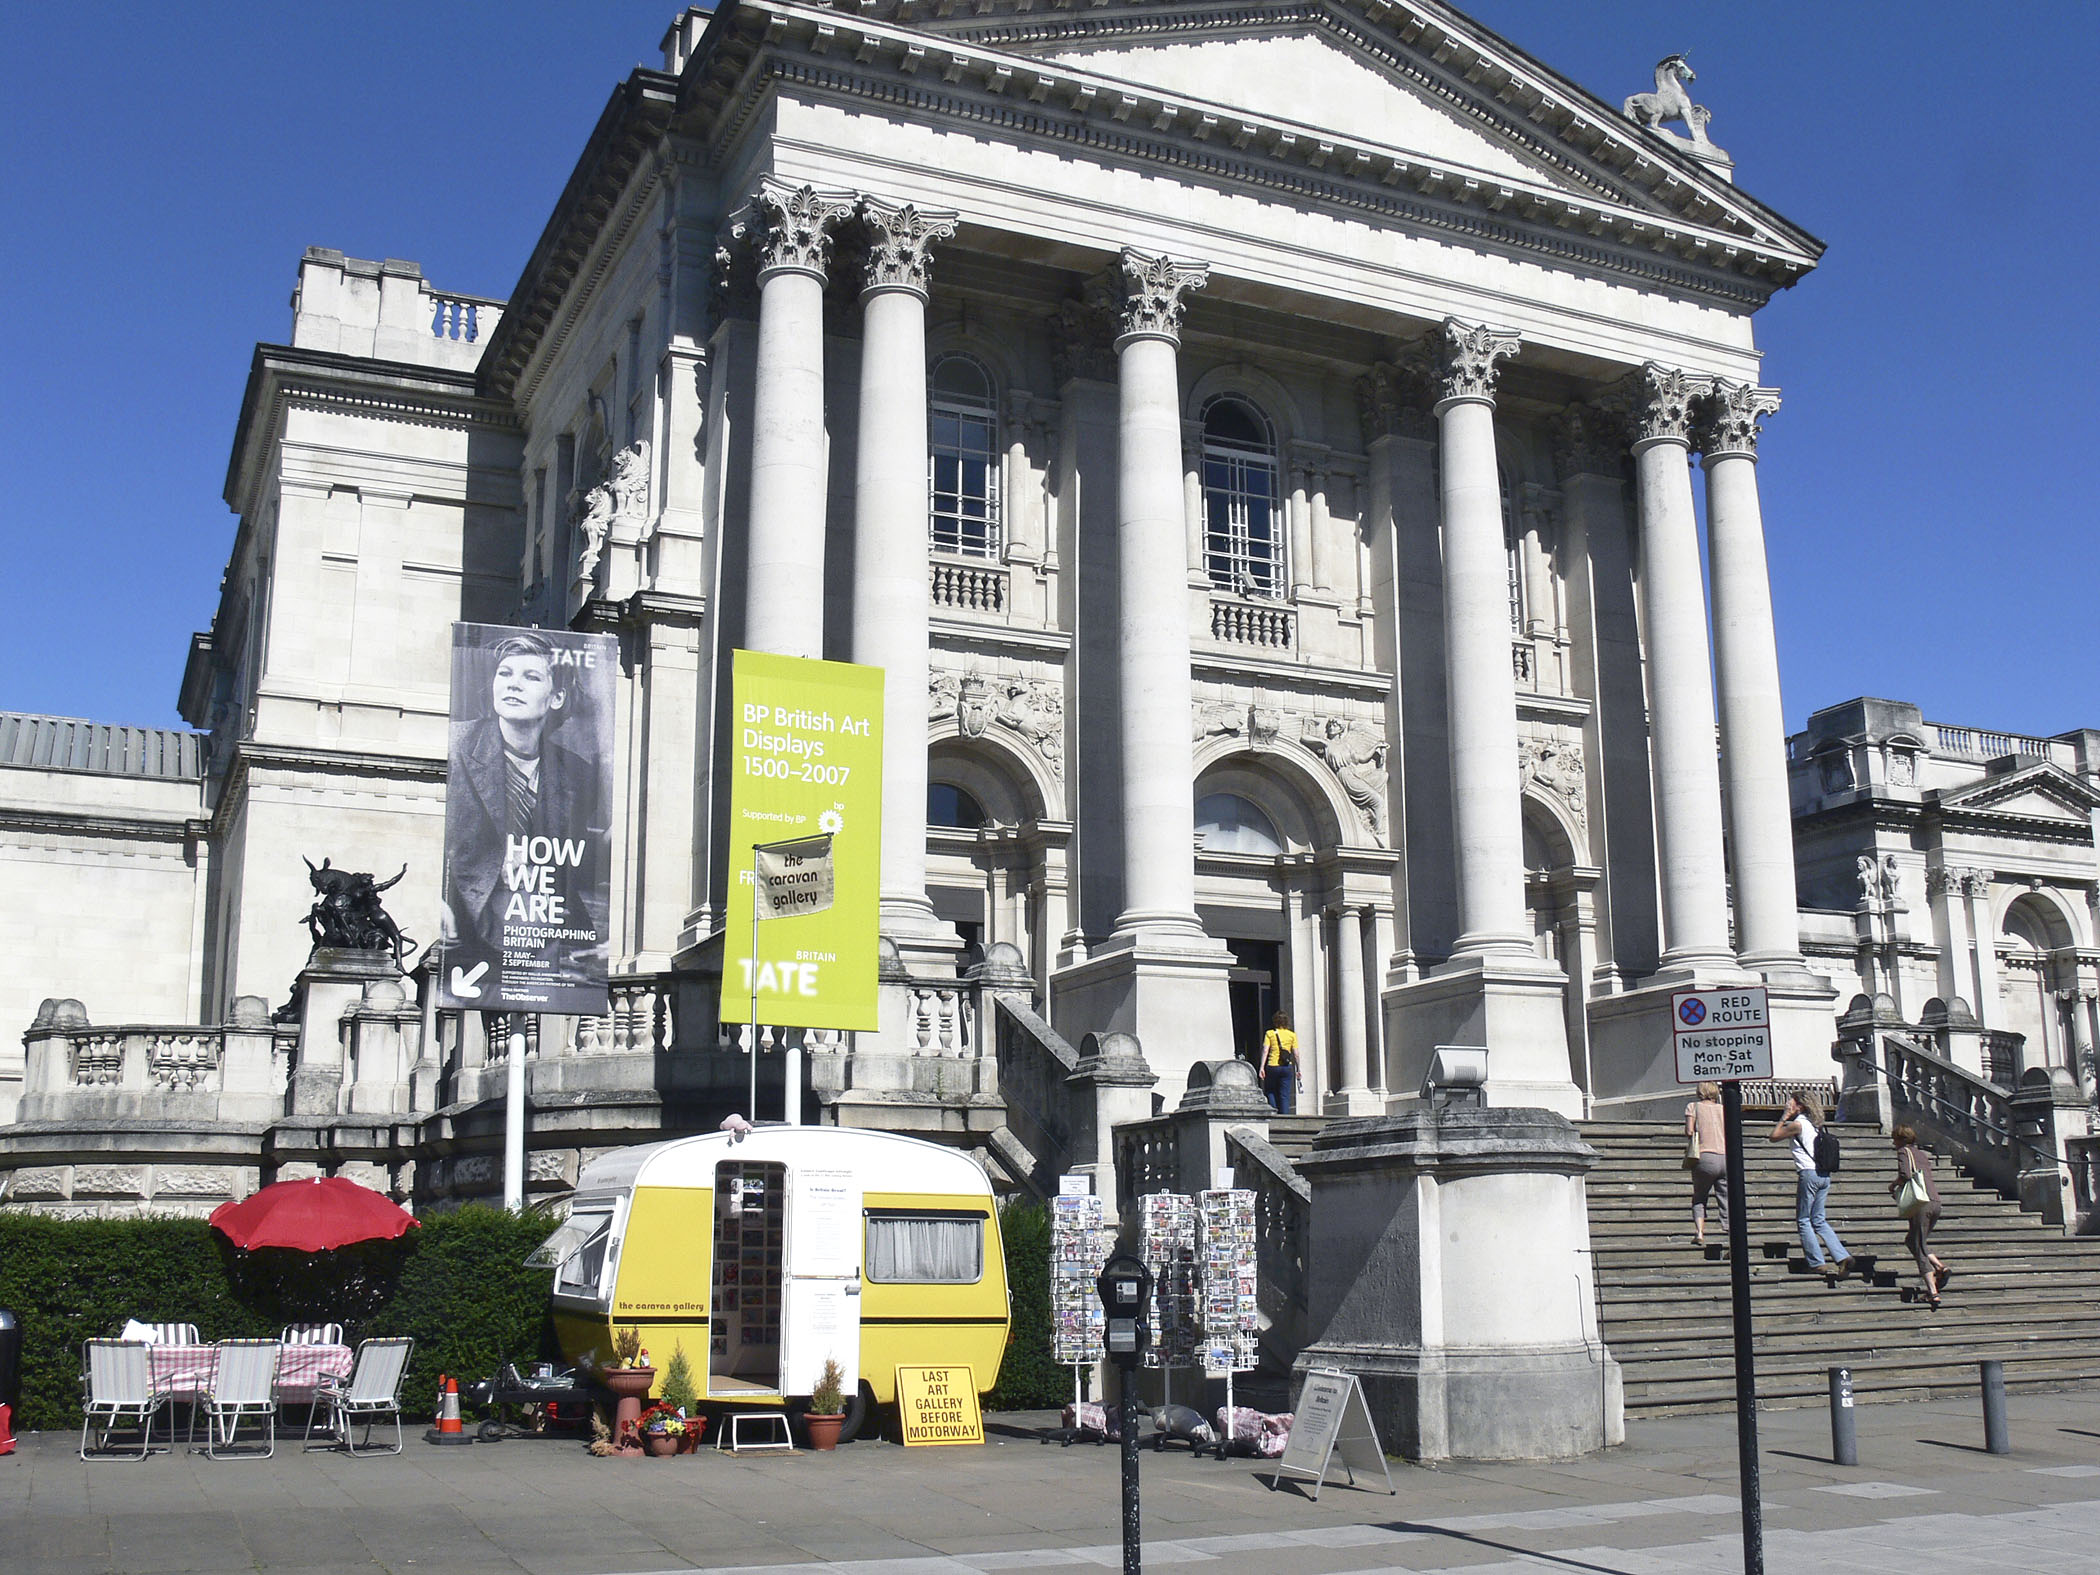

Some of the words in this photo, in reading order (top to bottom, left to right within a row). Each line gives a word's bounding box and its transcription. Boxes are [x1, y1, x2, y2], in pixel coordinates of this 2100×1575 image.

[550, 648, 596, 668] TATE
[743, 703, 770, 723] BP
[775, 707, 835, 732] British
[840, 715, 870, 736] Art
[743, 728, 824, 760] Displays
[743, 755, 850, 786] 1500–2007
[834, 801, 845, 811] bp
[742, 808, 783, 822] Supported
[785, 814, 795, 825] by
[796, 815, 807, 824] BP
[507, 834, 586, 867] HOW
[784, 853, 804, 867] the
[506, 863, 556, 894] WE
[769, 871, 818, 886] caravan
[773, 890, 818, 910] gallery
[504, 893, 565, 924] ARE
[503, 925, 596, 941] PHOTOGRAPHING
[503, 936, 545, 949] BRITAIN
[796, 950, 836, 963] BRITAIN
[508, 960, 550, 968] SEPTEMBER
[737, 957, 819, 997] TATE
[1721, 996, 1751, 1008] RED
[1712, 1009, 1761, 1023] ROUTE
[1682, 1037, 1701, 1048] No
[1705, 1034, 1763, 1048] stopping
[1694, 1049, 1753, 1063] Mon-Sat
[1693, 1063, 1754, 1075] 8am-7pm
[619, 1301, 633, 1310] the
[673, 1302, 704, 1312] gallery
[922, 1371, 949, 1382] LAST
[928, 1384, 949, 1395] ART
[915, 1398, 963, 1410] GALLERY
[920, 1411, 963, 1423] BEFORE
[909, 1425, 976, 1438] MOTORWAY
